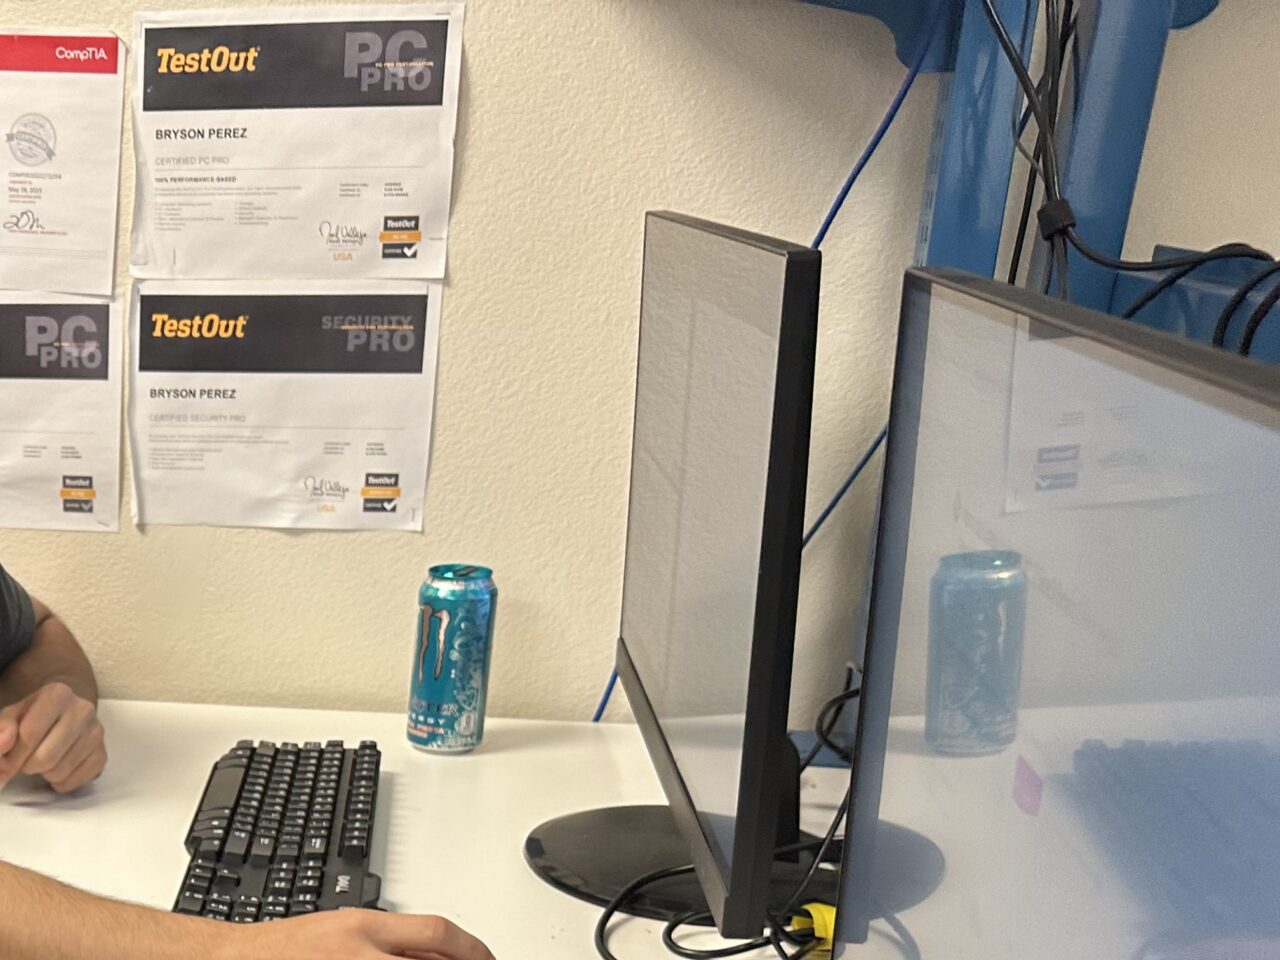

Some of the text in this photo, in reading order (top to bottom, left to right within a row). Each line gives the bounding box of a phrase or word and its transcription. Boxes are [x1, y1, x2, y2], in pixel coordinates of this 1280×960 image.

[55, 46, 108, 62] CompTIA
[157, 46, 258, 73] TestOut
[344, 30, 428, 78] PC
[360, 66, 432, 91] PRO
[156, 128, 248, 140] BRYSON PEREZ
[155, 156, 230, 165] CERTIFIED PC PRO
[152, 314, 247, 338] TestOut
[321, 316, 412, 330] SECURITY
[25, 315, 97, 356] PC
[347, 330, 415, 352] PRO
[40, 346, 102, 369] PRO
[150, 389, 236, 398] BRYSON PEREZ
